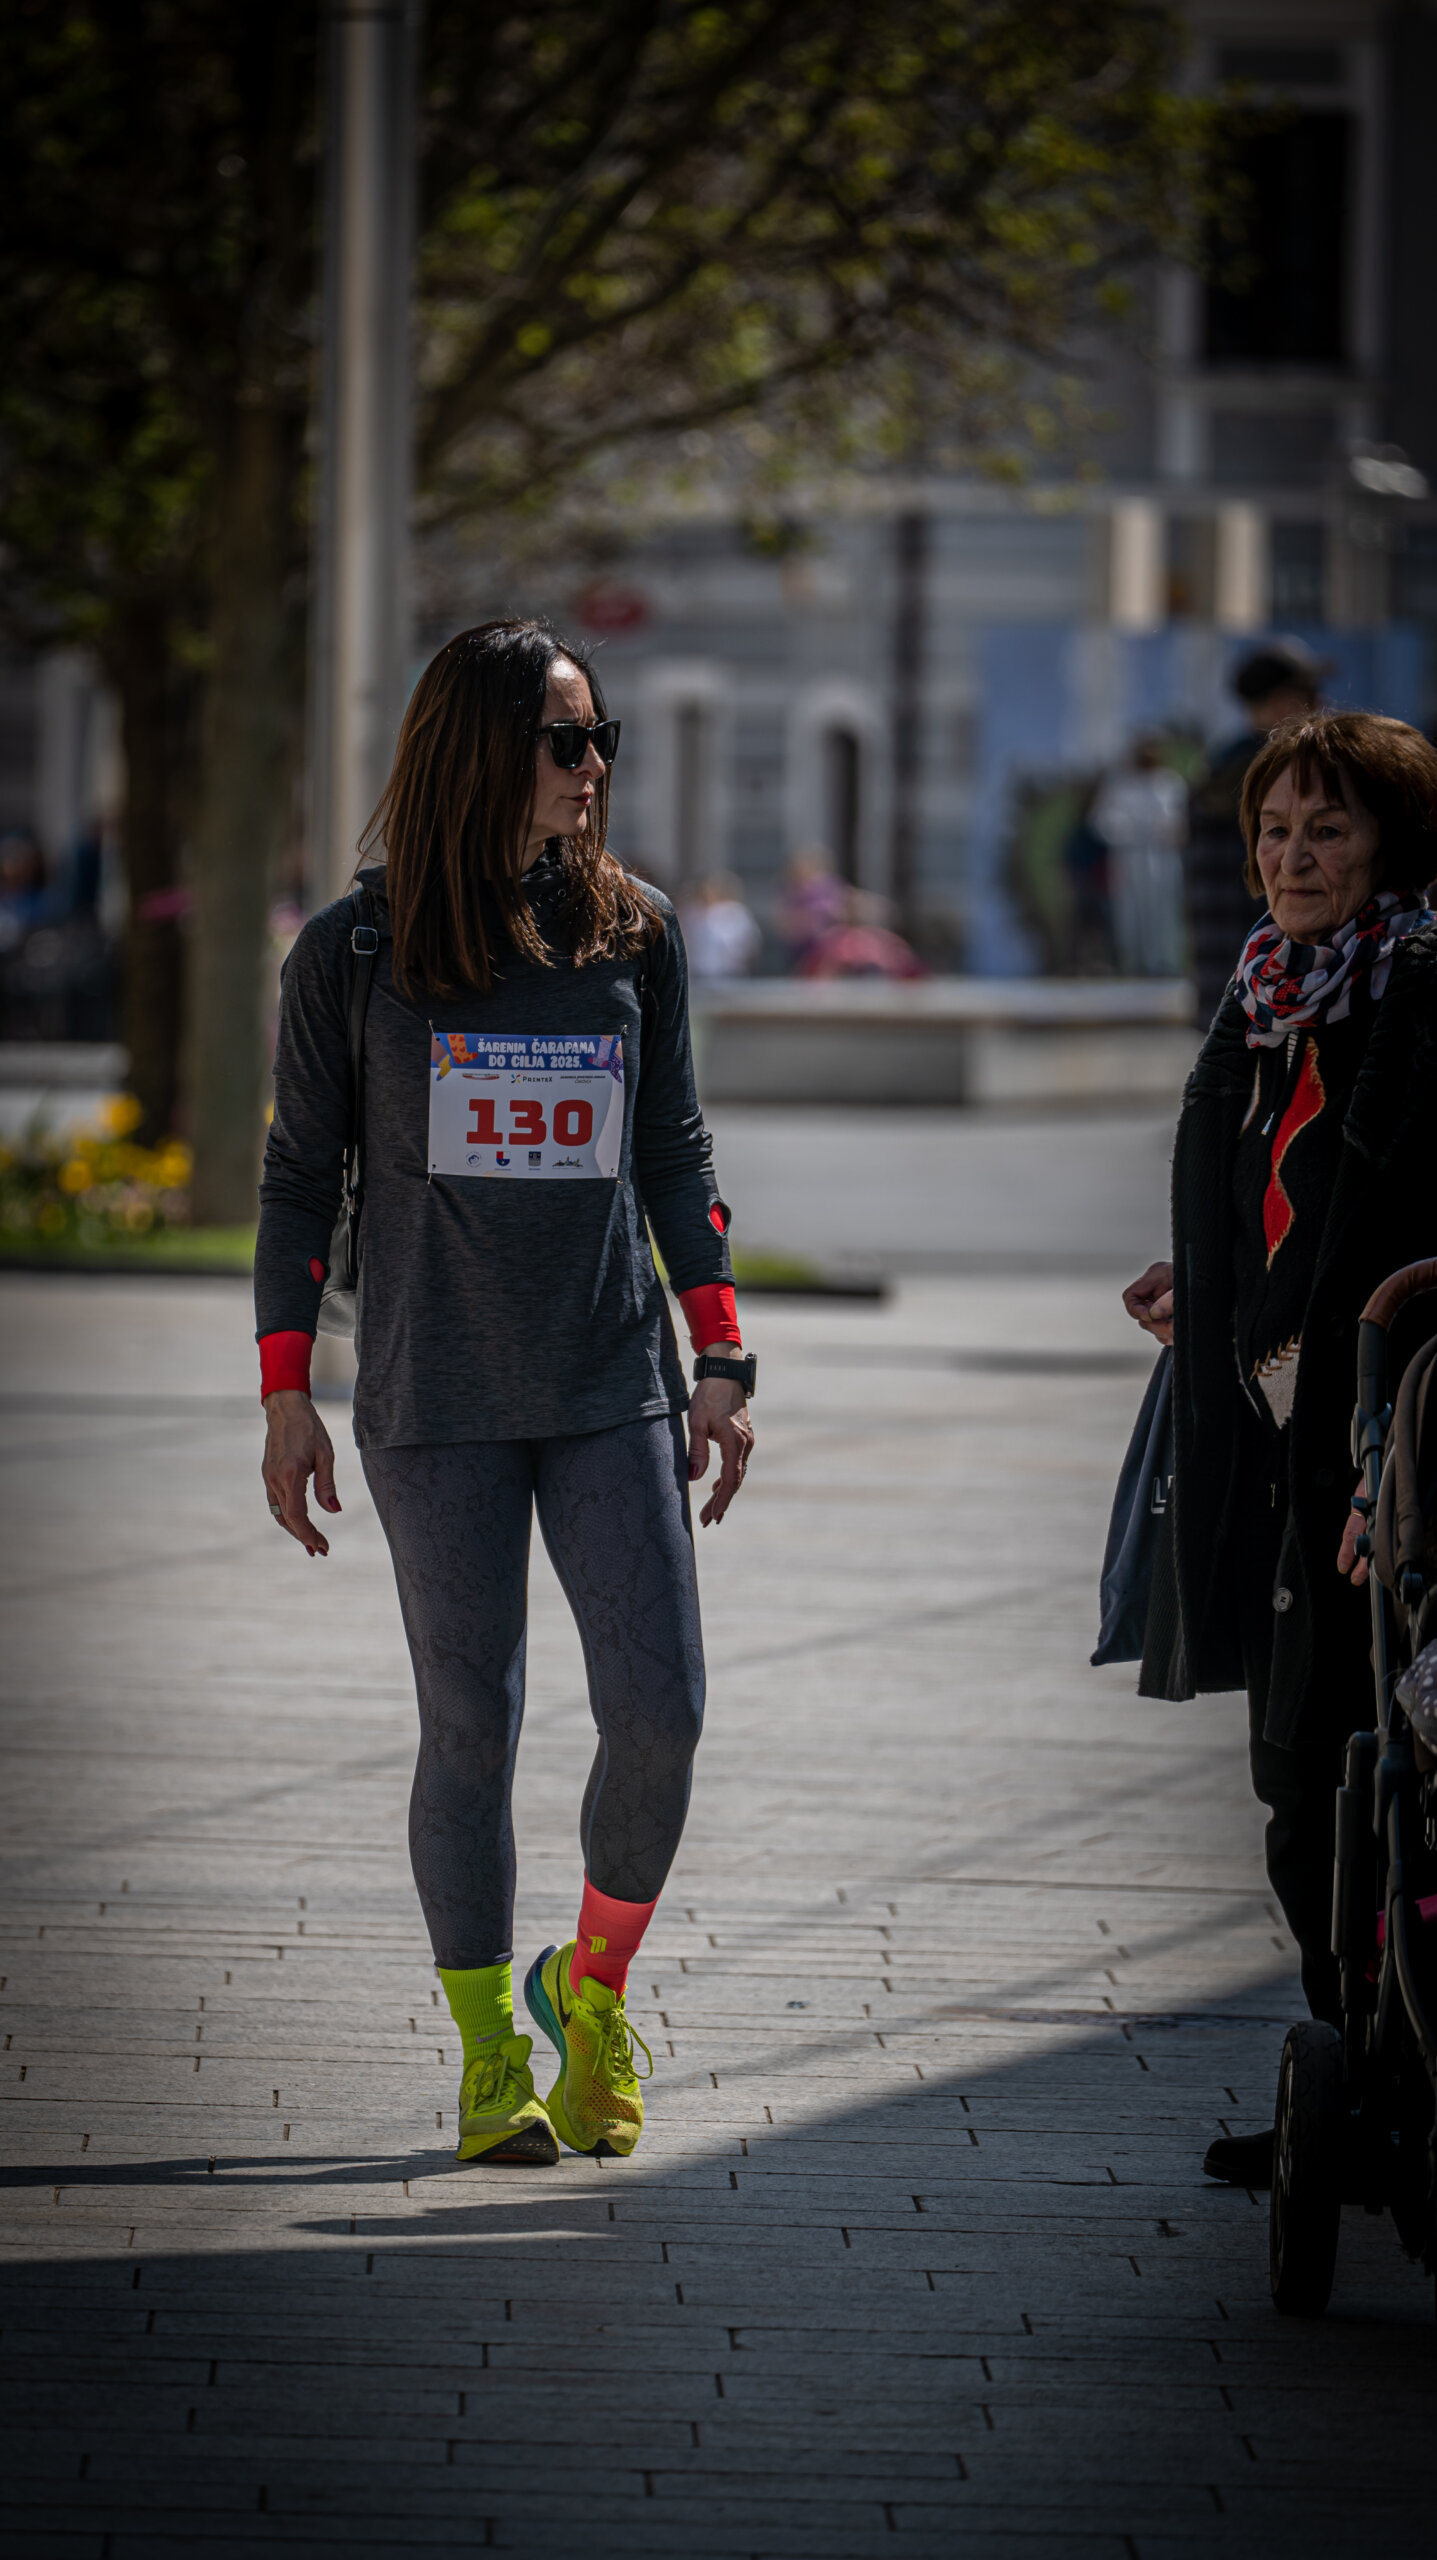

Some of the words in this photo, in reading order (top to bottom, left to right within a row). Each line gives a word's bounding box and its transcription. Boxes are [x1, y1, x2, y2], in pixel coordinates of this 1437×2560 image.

[478, 1037, 526, 1054] ŠARENIM
[531, 1037, 596, 1055] ČARAPAMA
[488, 1054, 506, 1068] DO
[511, 1055, 545, 1069] CILJA
[550, 1055, 583, 1069] 2025.
[466, 1098, 593, 1147] 130
